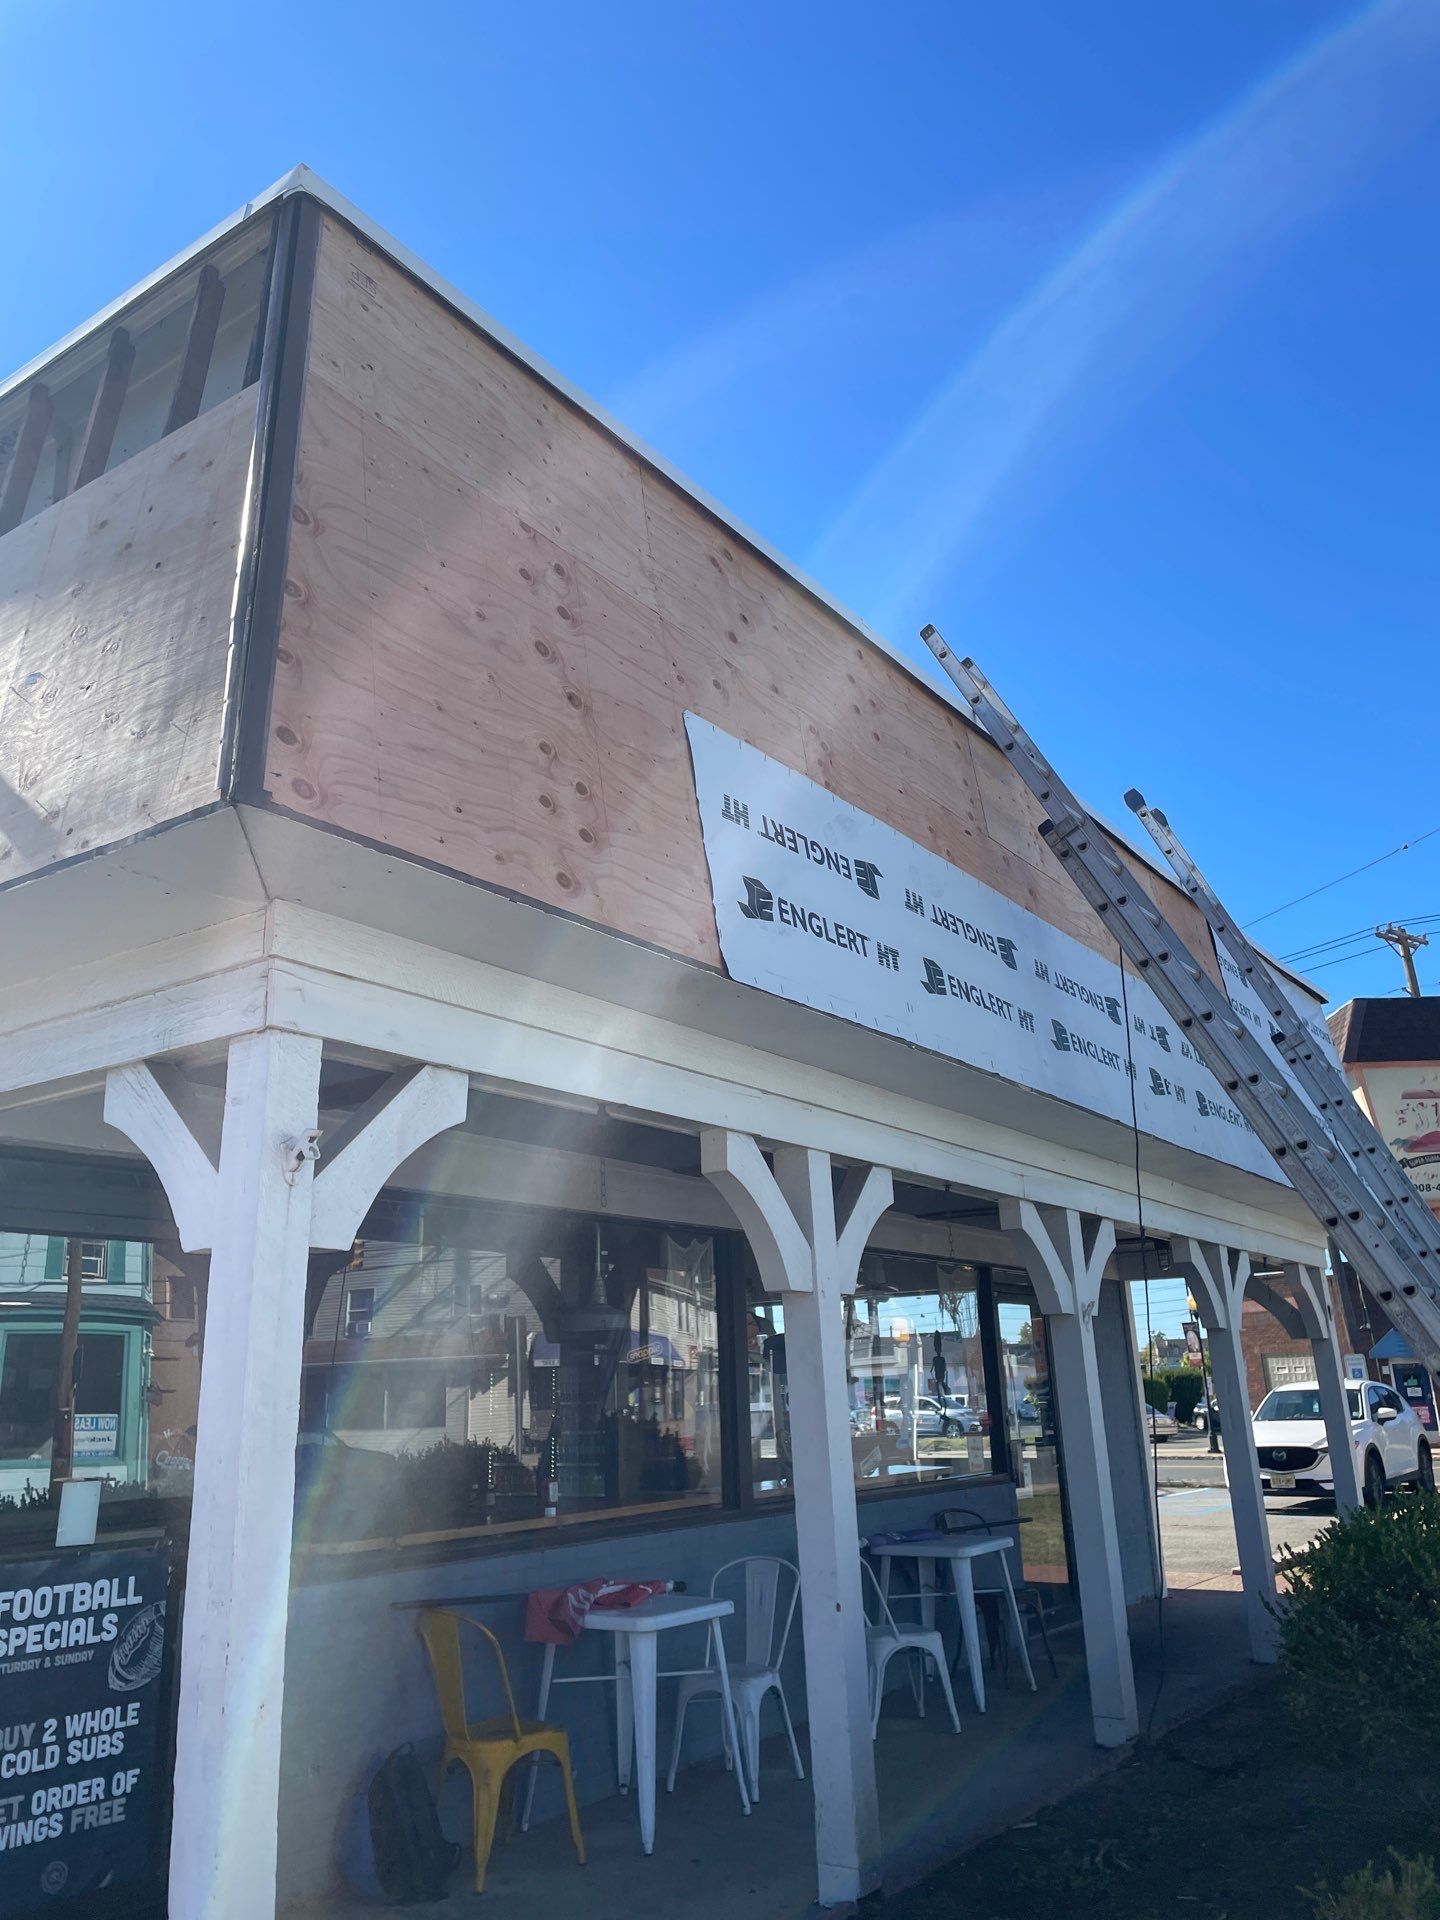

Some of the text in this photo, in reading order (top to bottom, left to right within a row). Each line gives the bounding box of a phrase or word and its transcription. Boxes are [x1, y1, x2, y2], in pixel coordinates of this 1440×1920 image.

[722, 794, 853, 880] ENGLERT HT
[777, 896, 900, 971] ENGLERT HT
[905, 888, 998, 955] ENGLERT HT
[948, 974, 1035, 1033] ENGLERT HT
[1034, 959, 1105, 1013] ENGLERT HT
[1070, 1033, 1121, 1071] ENGLERT
[0, 1575, 143, 1622] FOOTBALL
[54, 1650, 95, 1667] SUNDAY
[0, 1702, 141, 1751] UY 2 WHOLE
[1, 1731, 124, 1779] COLD SUBS
[31, 1777, 105, 1816] ORDER
[111, 1768, 140, 1797] OF
[70, 1797, 126, 1834] FREE
